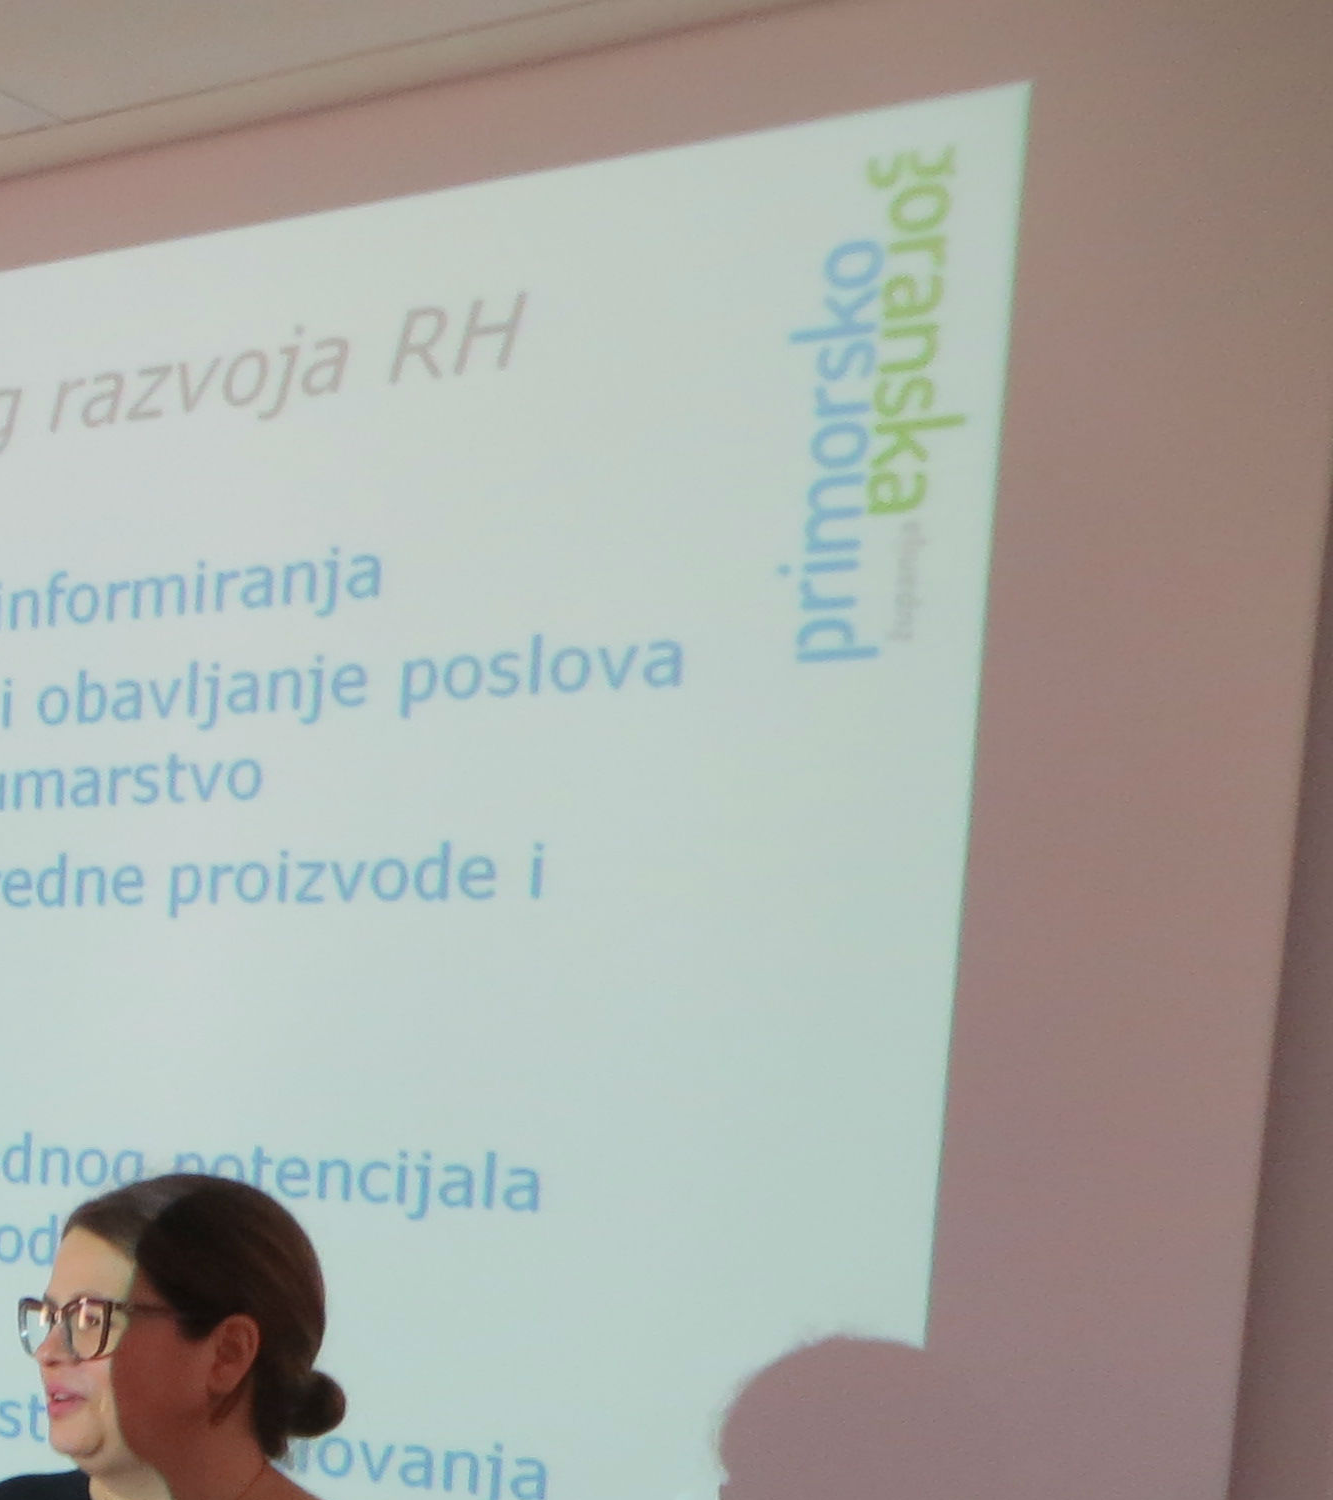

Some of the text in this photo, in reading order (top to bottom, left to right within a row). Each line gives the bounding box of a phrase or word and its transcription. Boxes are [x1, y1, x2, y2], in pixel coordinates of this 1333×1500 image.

[47, 325, 351, 433] razvoja
[388, 291, 529, 385] RH
[866, 144, 967, 516] goranska
[776, 239, 886, 664] primorsko
[1, 677, 13, 729] i
[36, 654, 369, 731] obavljanje
[399, 633, 686, 719] poslova
[168, 840, 497, 918] proizvode
[532, 841, 545, 900] i
